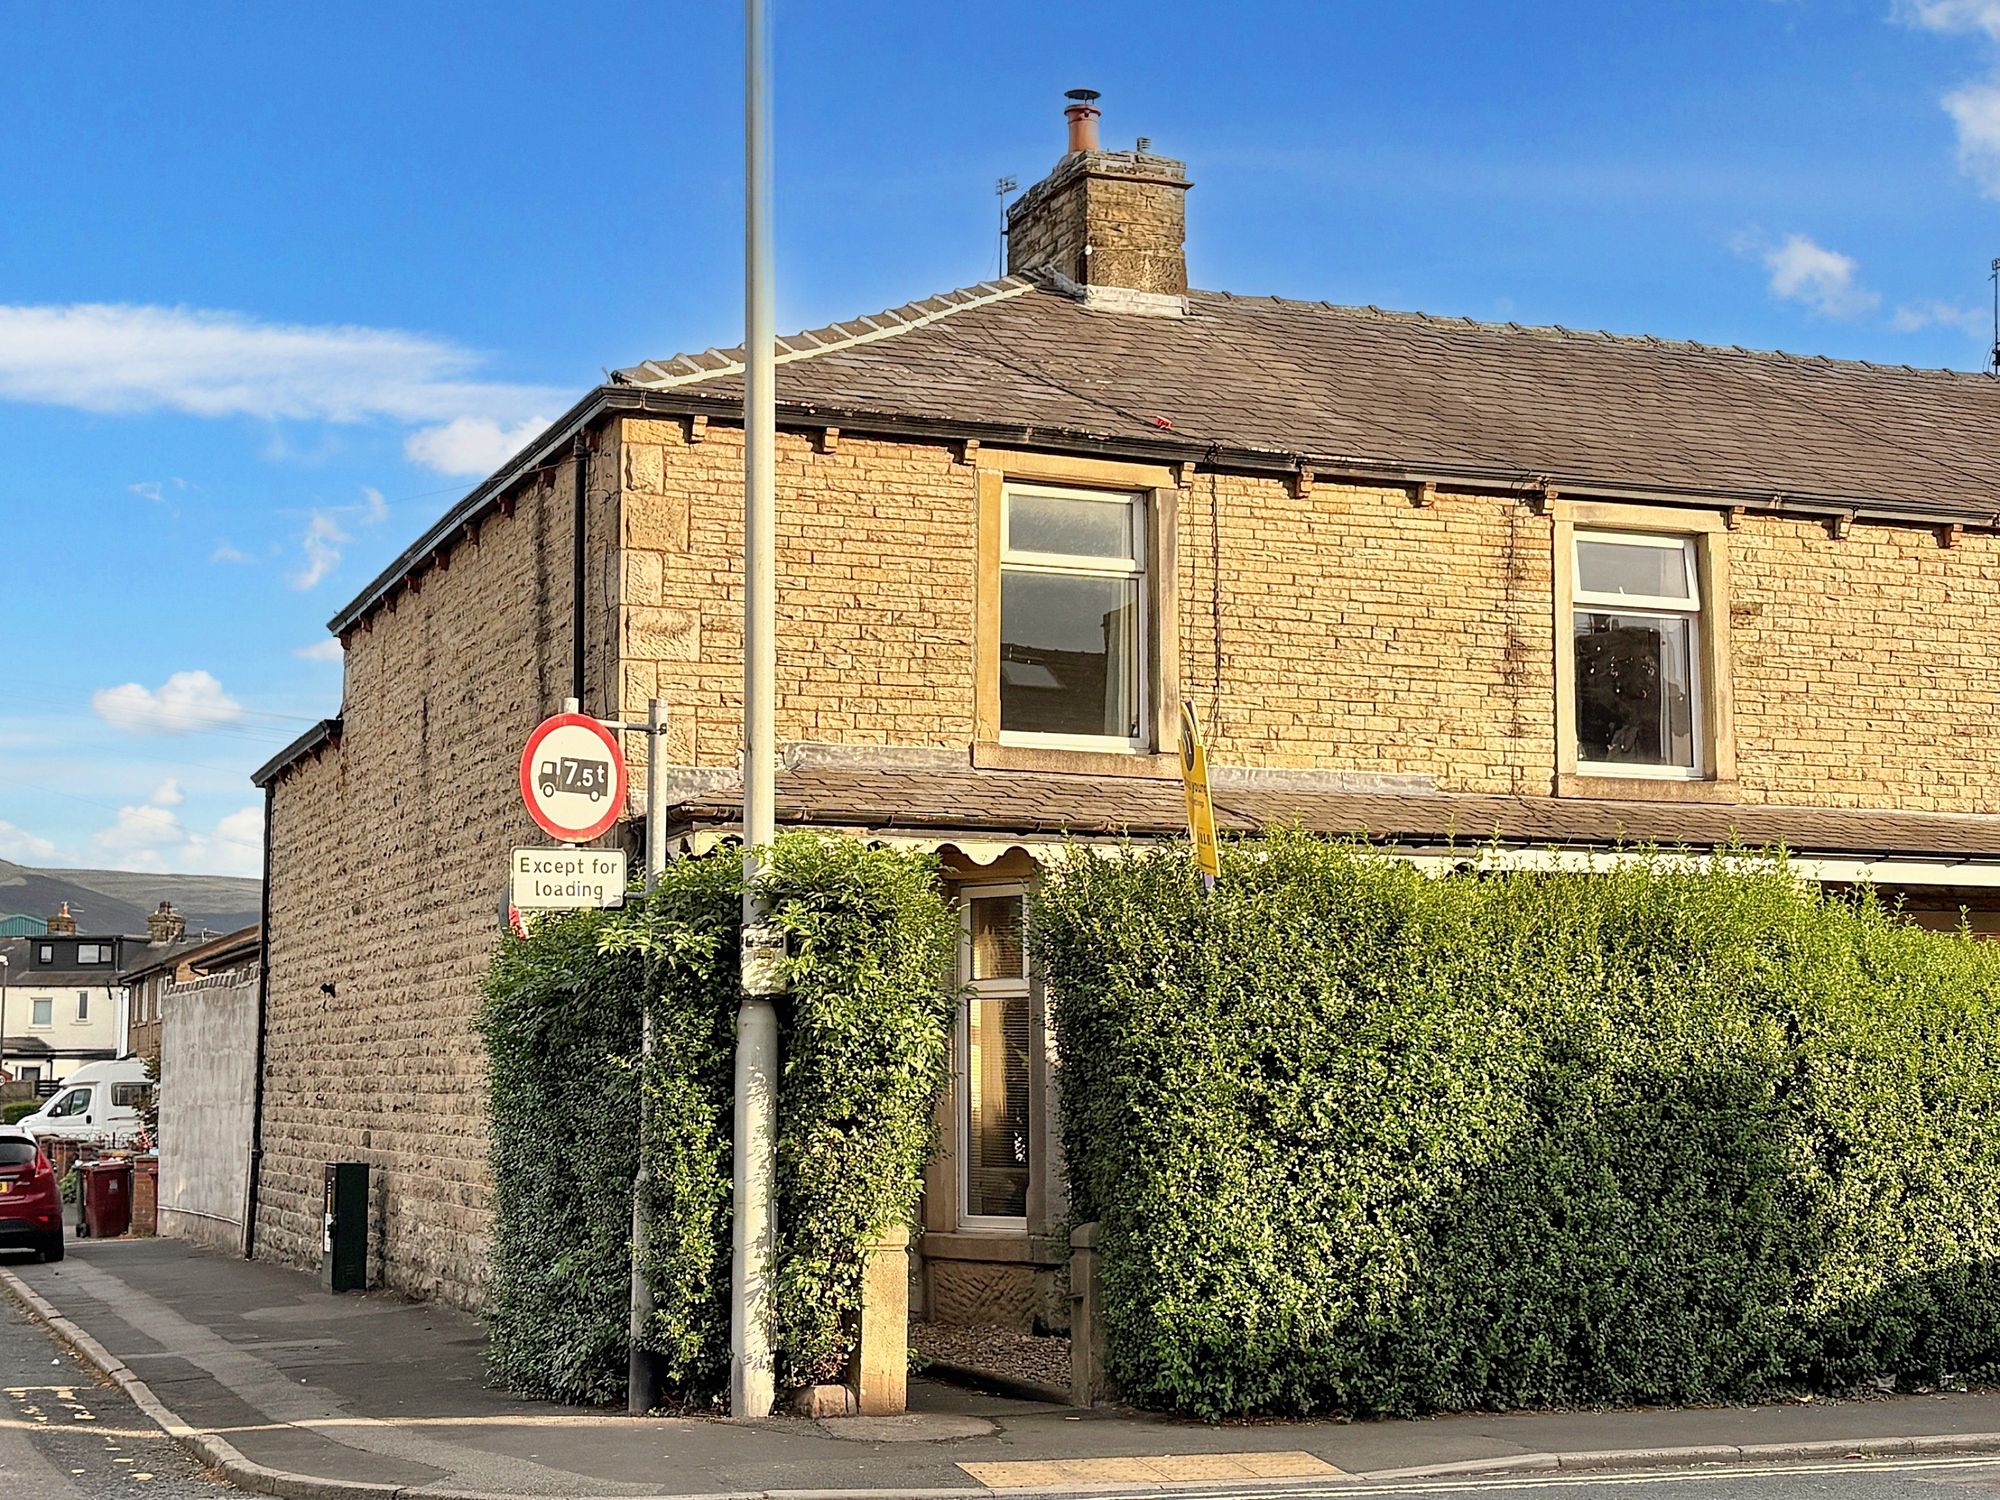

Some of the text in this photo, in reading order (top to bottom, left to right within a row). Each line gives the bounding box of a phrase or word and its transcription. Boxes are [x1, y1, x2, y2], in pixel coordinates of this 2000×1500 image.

[564, 761, 605, 787] 7.5t
[520, 857, 617, 876] Except for
[535, 880, 603, 900] loading
